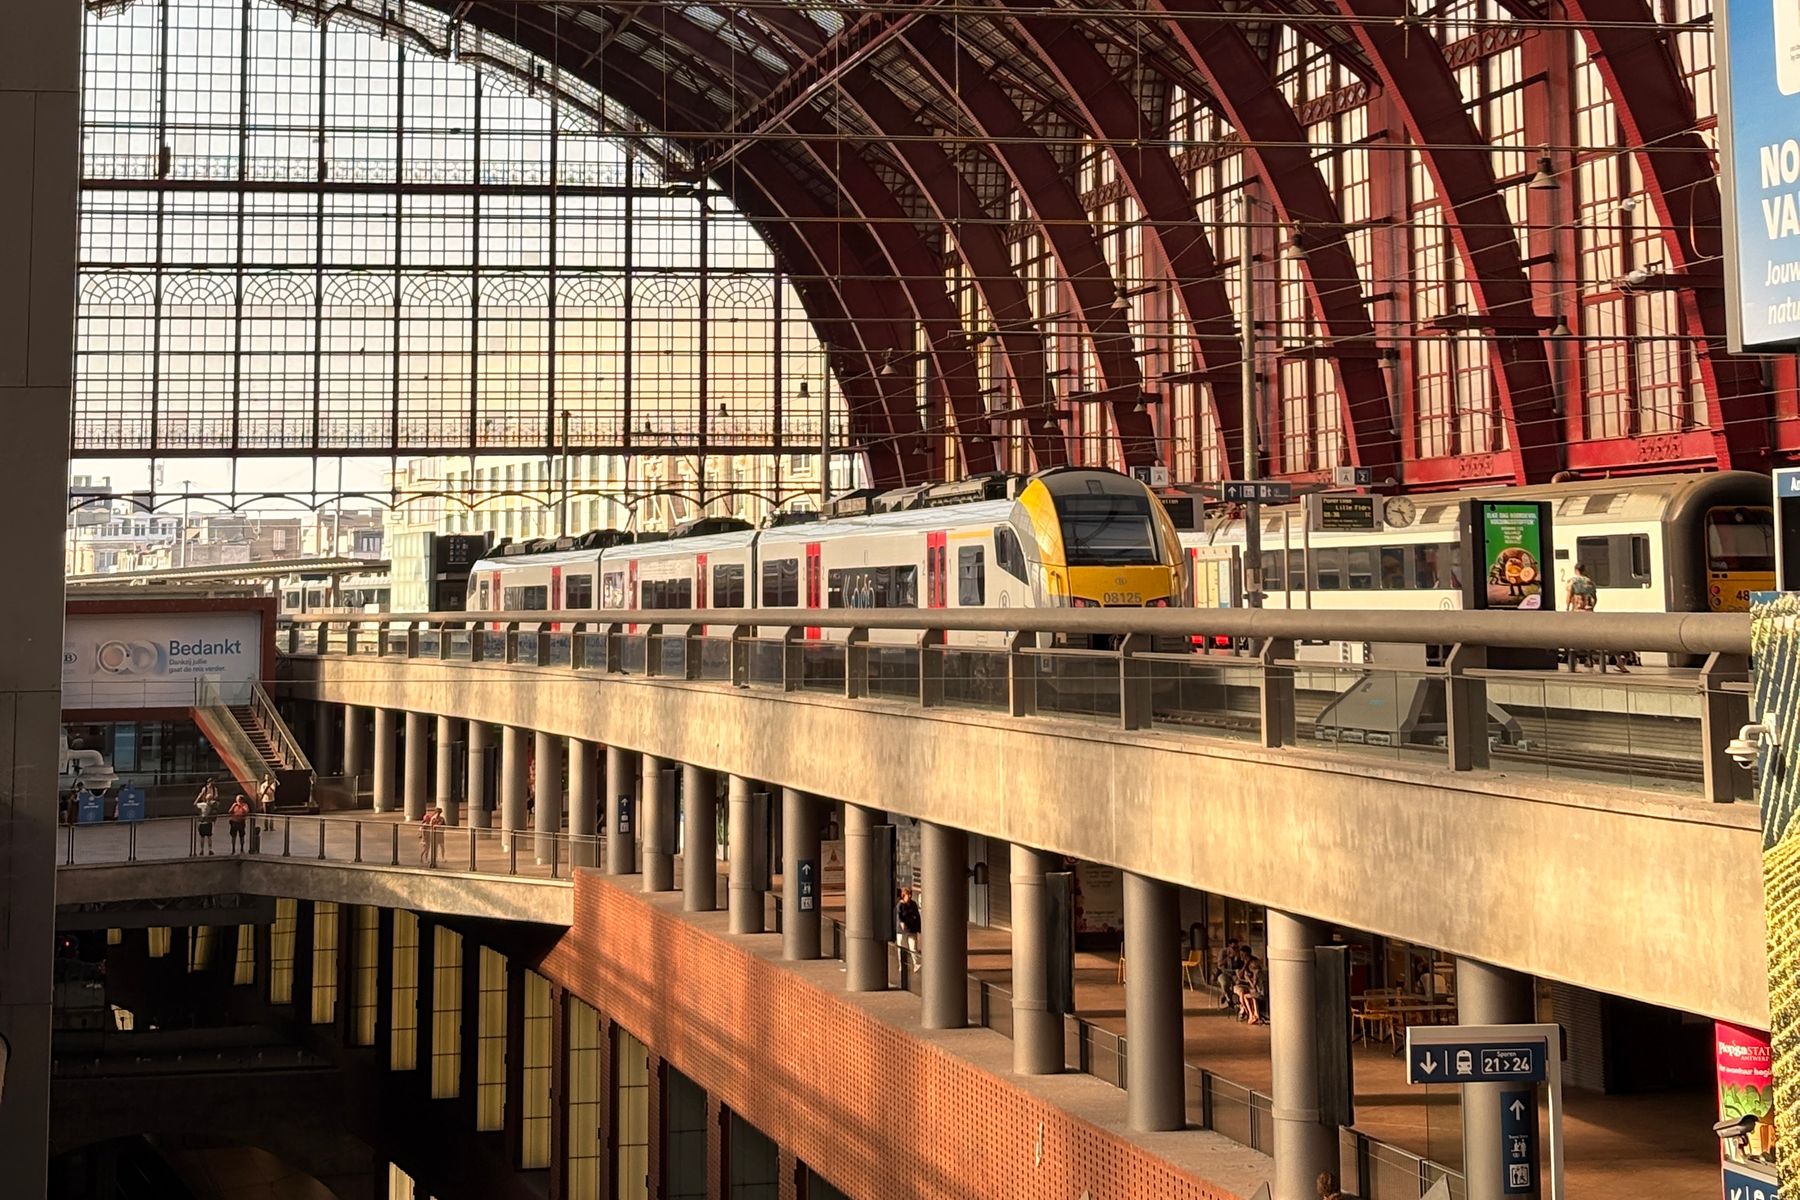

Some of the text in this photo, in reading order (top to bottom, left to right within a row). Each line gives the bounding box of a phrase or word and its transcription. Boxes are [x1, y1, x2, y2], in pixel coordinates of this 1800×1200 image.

[1103, 592, 1142, 604] 08125
[169, 639, 241, 656] Bedankt
[1484, 1057, 1530, 1072] 21 24
